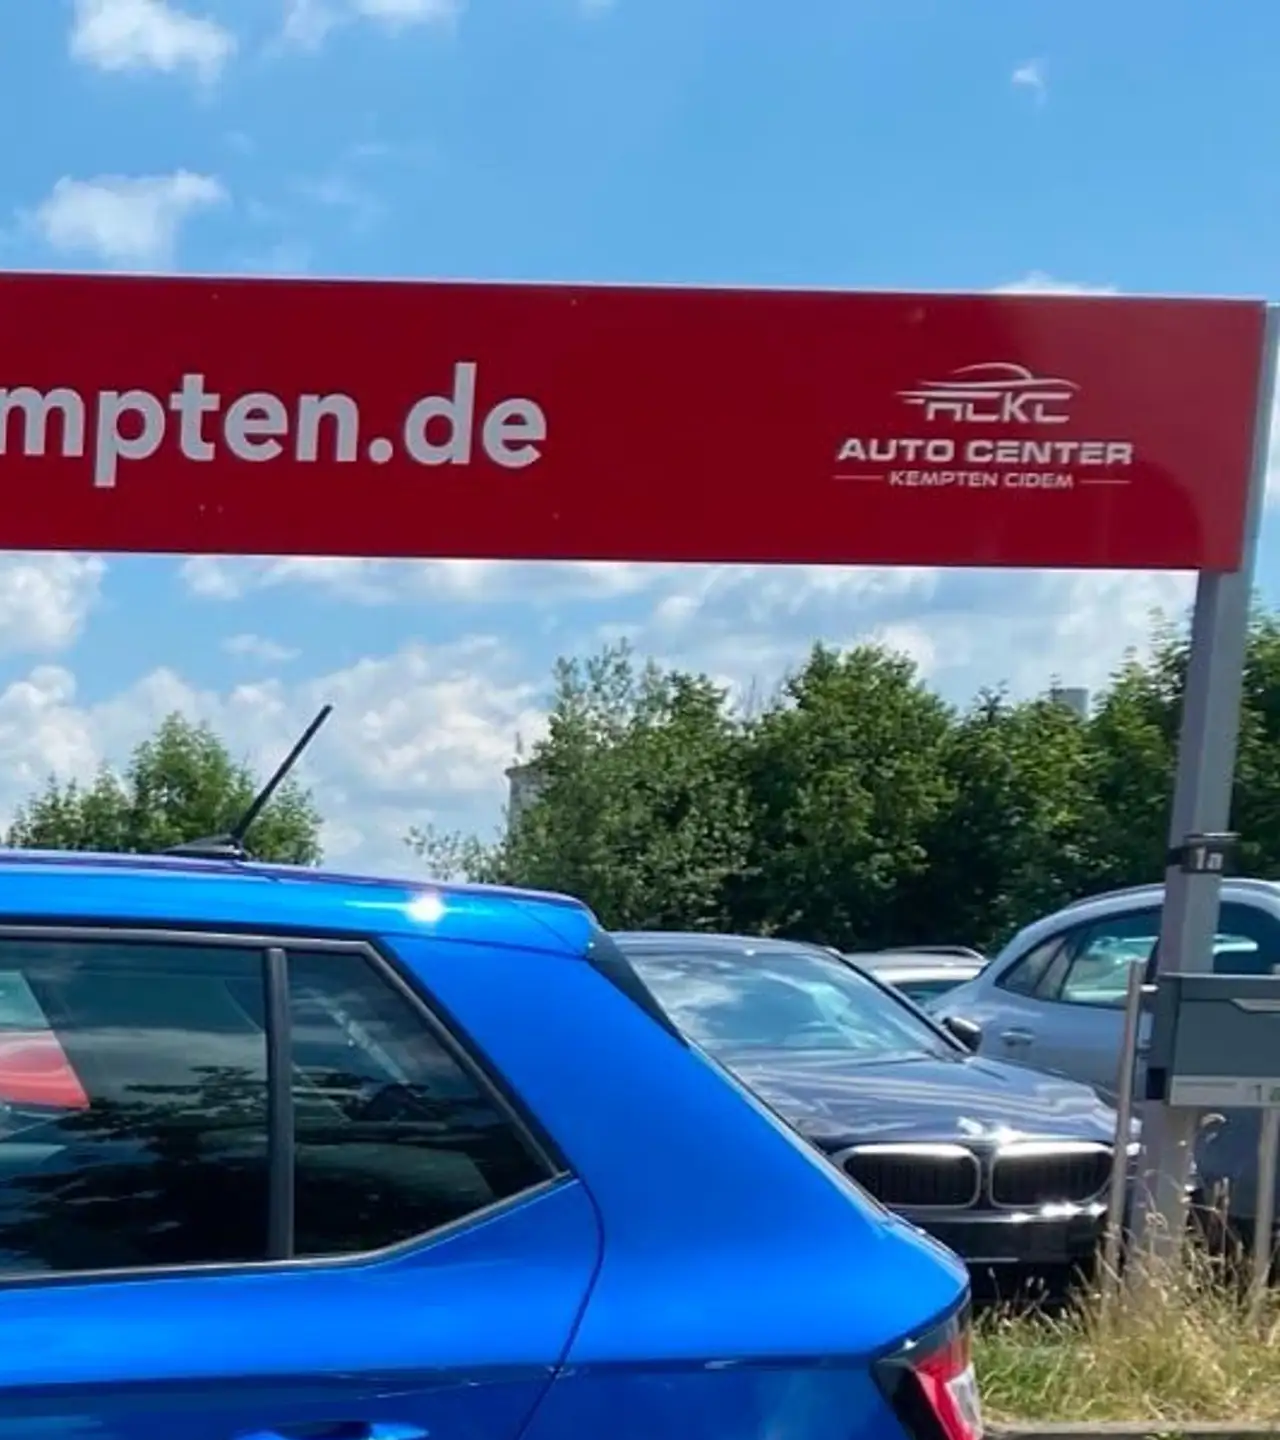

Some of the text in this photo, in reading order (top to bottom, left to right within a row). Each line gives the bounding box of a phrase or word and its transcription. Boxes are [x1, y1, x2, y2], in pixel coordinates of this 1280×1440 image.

[836, 438, 1134, 466] AUTO CENTER
[888, 470, 1075, 490] KEMPTEN CIDEM
